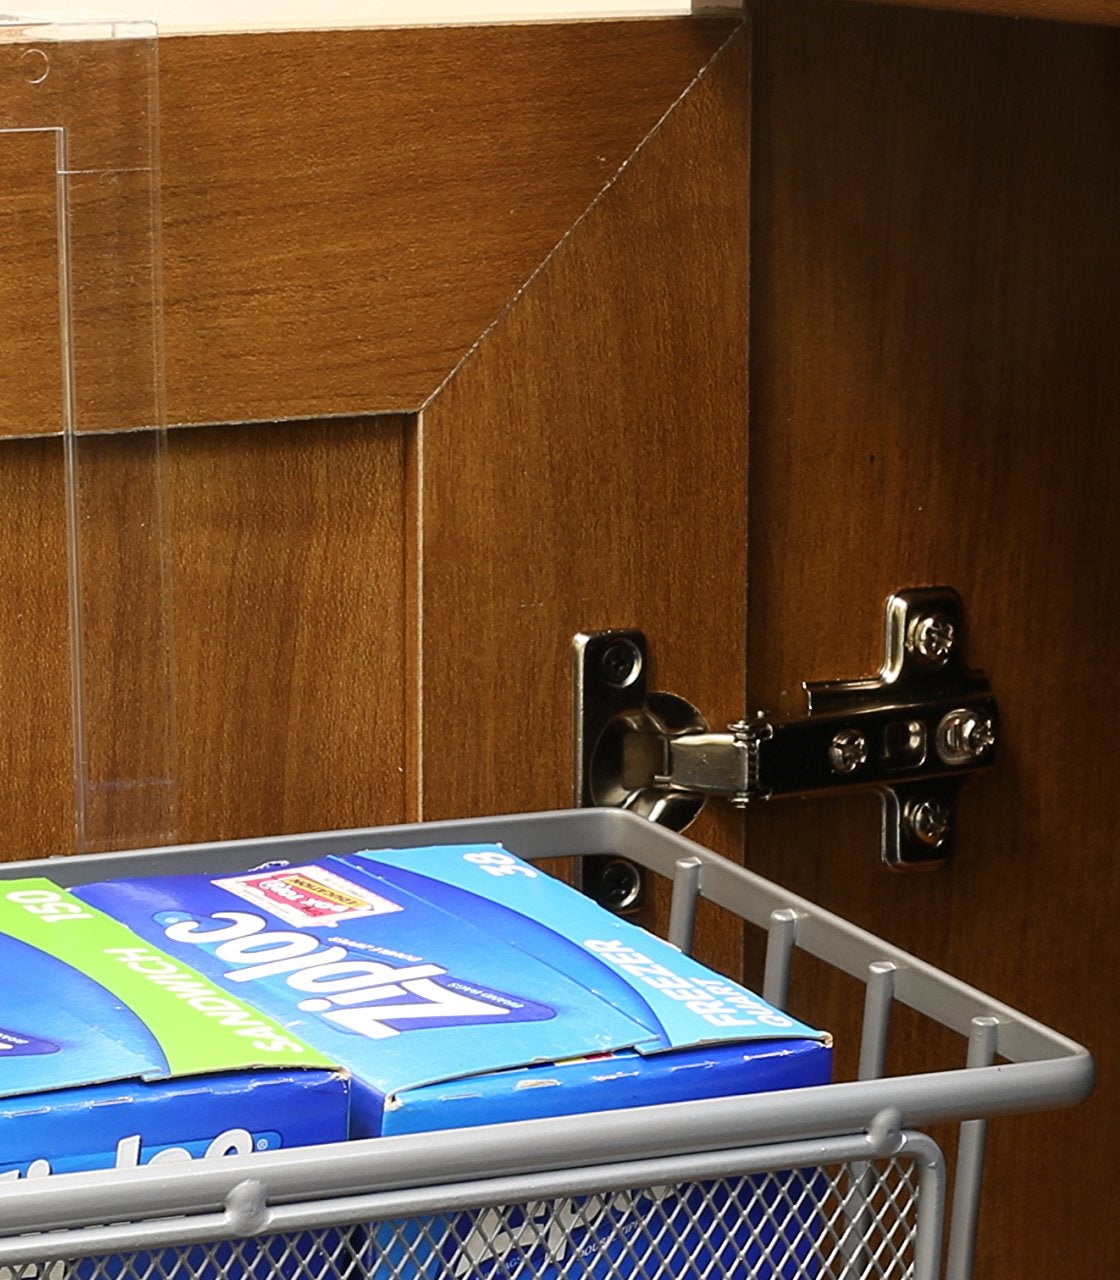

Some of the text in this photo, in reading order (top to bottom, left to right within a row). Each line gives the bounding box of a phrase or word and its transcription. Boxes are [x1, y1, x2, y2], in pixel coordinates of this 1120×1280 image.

[286, 878, 358, 906] EDUCATION
[461, 851, 539, 881] 38
[5, 889, 95, 923] 150
[102, 946, 304, 1054] SANDWICH
[164, 910, 511, 1040] Ziploc
[583, 938, 758, 1028] FREEZER
